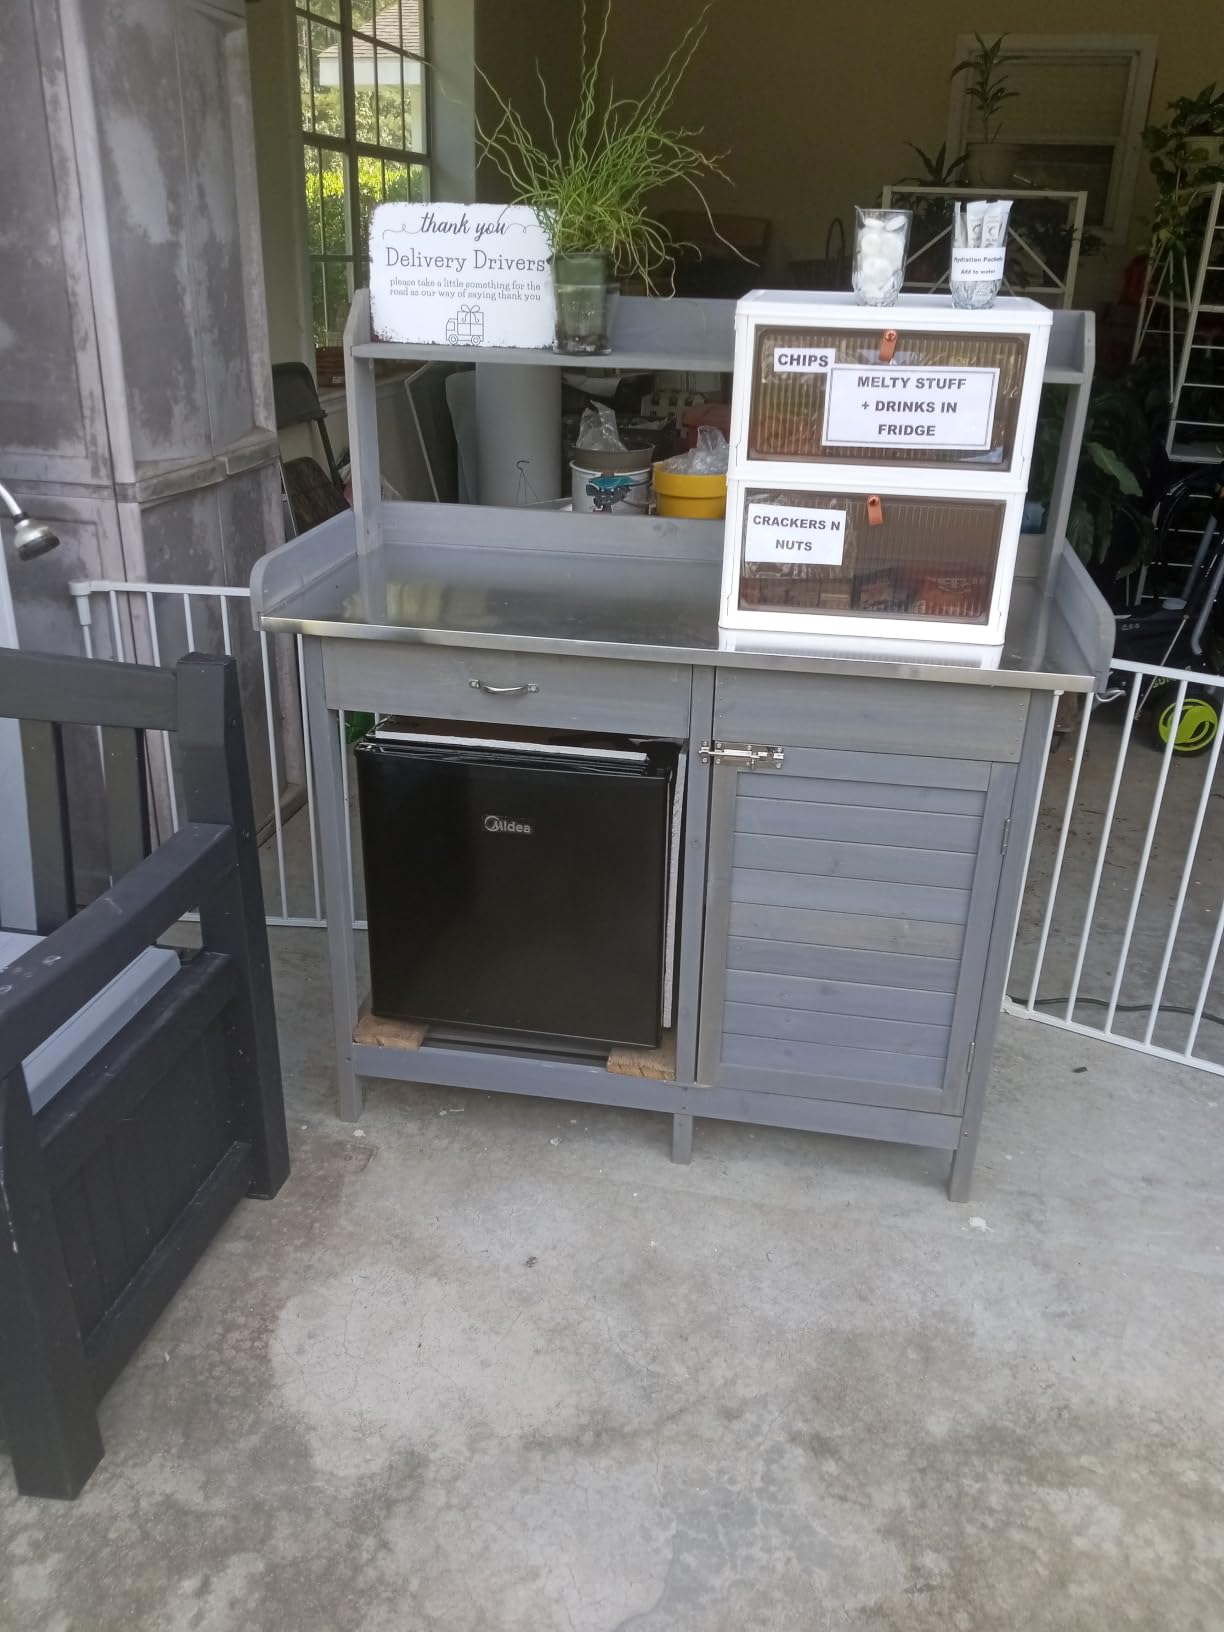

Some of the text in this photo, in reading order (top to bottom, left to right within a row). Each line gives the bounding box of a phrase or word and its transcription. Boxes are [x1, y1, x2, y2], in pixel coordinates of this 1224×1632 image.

[420, 211, 507, 242] thank you
[386, 246, 546, 272] Delivery Drivers
[390, 276, 416, 287] please
[418, 276, 436, 287] take
[443, 277, 464, 288] little
[465, 279, 511, 292] something
[512, 280, 525, 290] for
[527, 281, 541, 291] the
[390, 286, 409, 296] road
[421, 289, 436, 297] our
[438, 290, 455, 299] way
[457, 288, 467, 298] of
[467, 289, 497, 301] saying
[498, 289, 522, 301] thank
[524, 293, 541, 302] you
[777, 353, 829, 368] CHIPS
[857, 376, 967, 390] MELTY STUFF
[875, 400, 936, 413] DRINKS
[941, 401, 958, 414] IN
[877, 423, 937, 437] FRIDGE
[752, 514, 841, 532] CRACKERS N
[775, 539, 813, 552] NUTS
[484, 815, 531, 833] Midea
